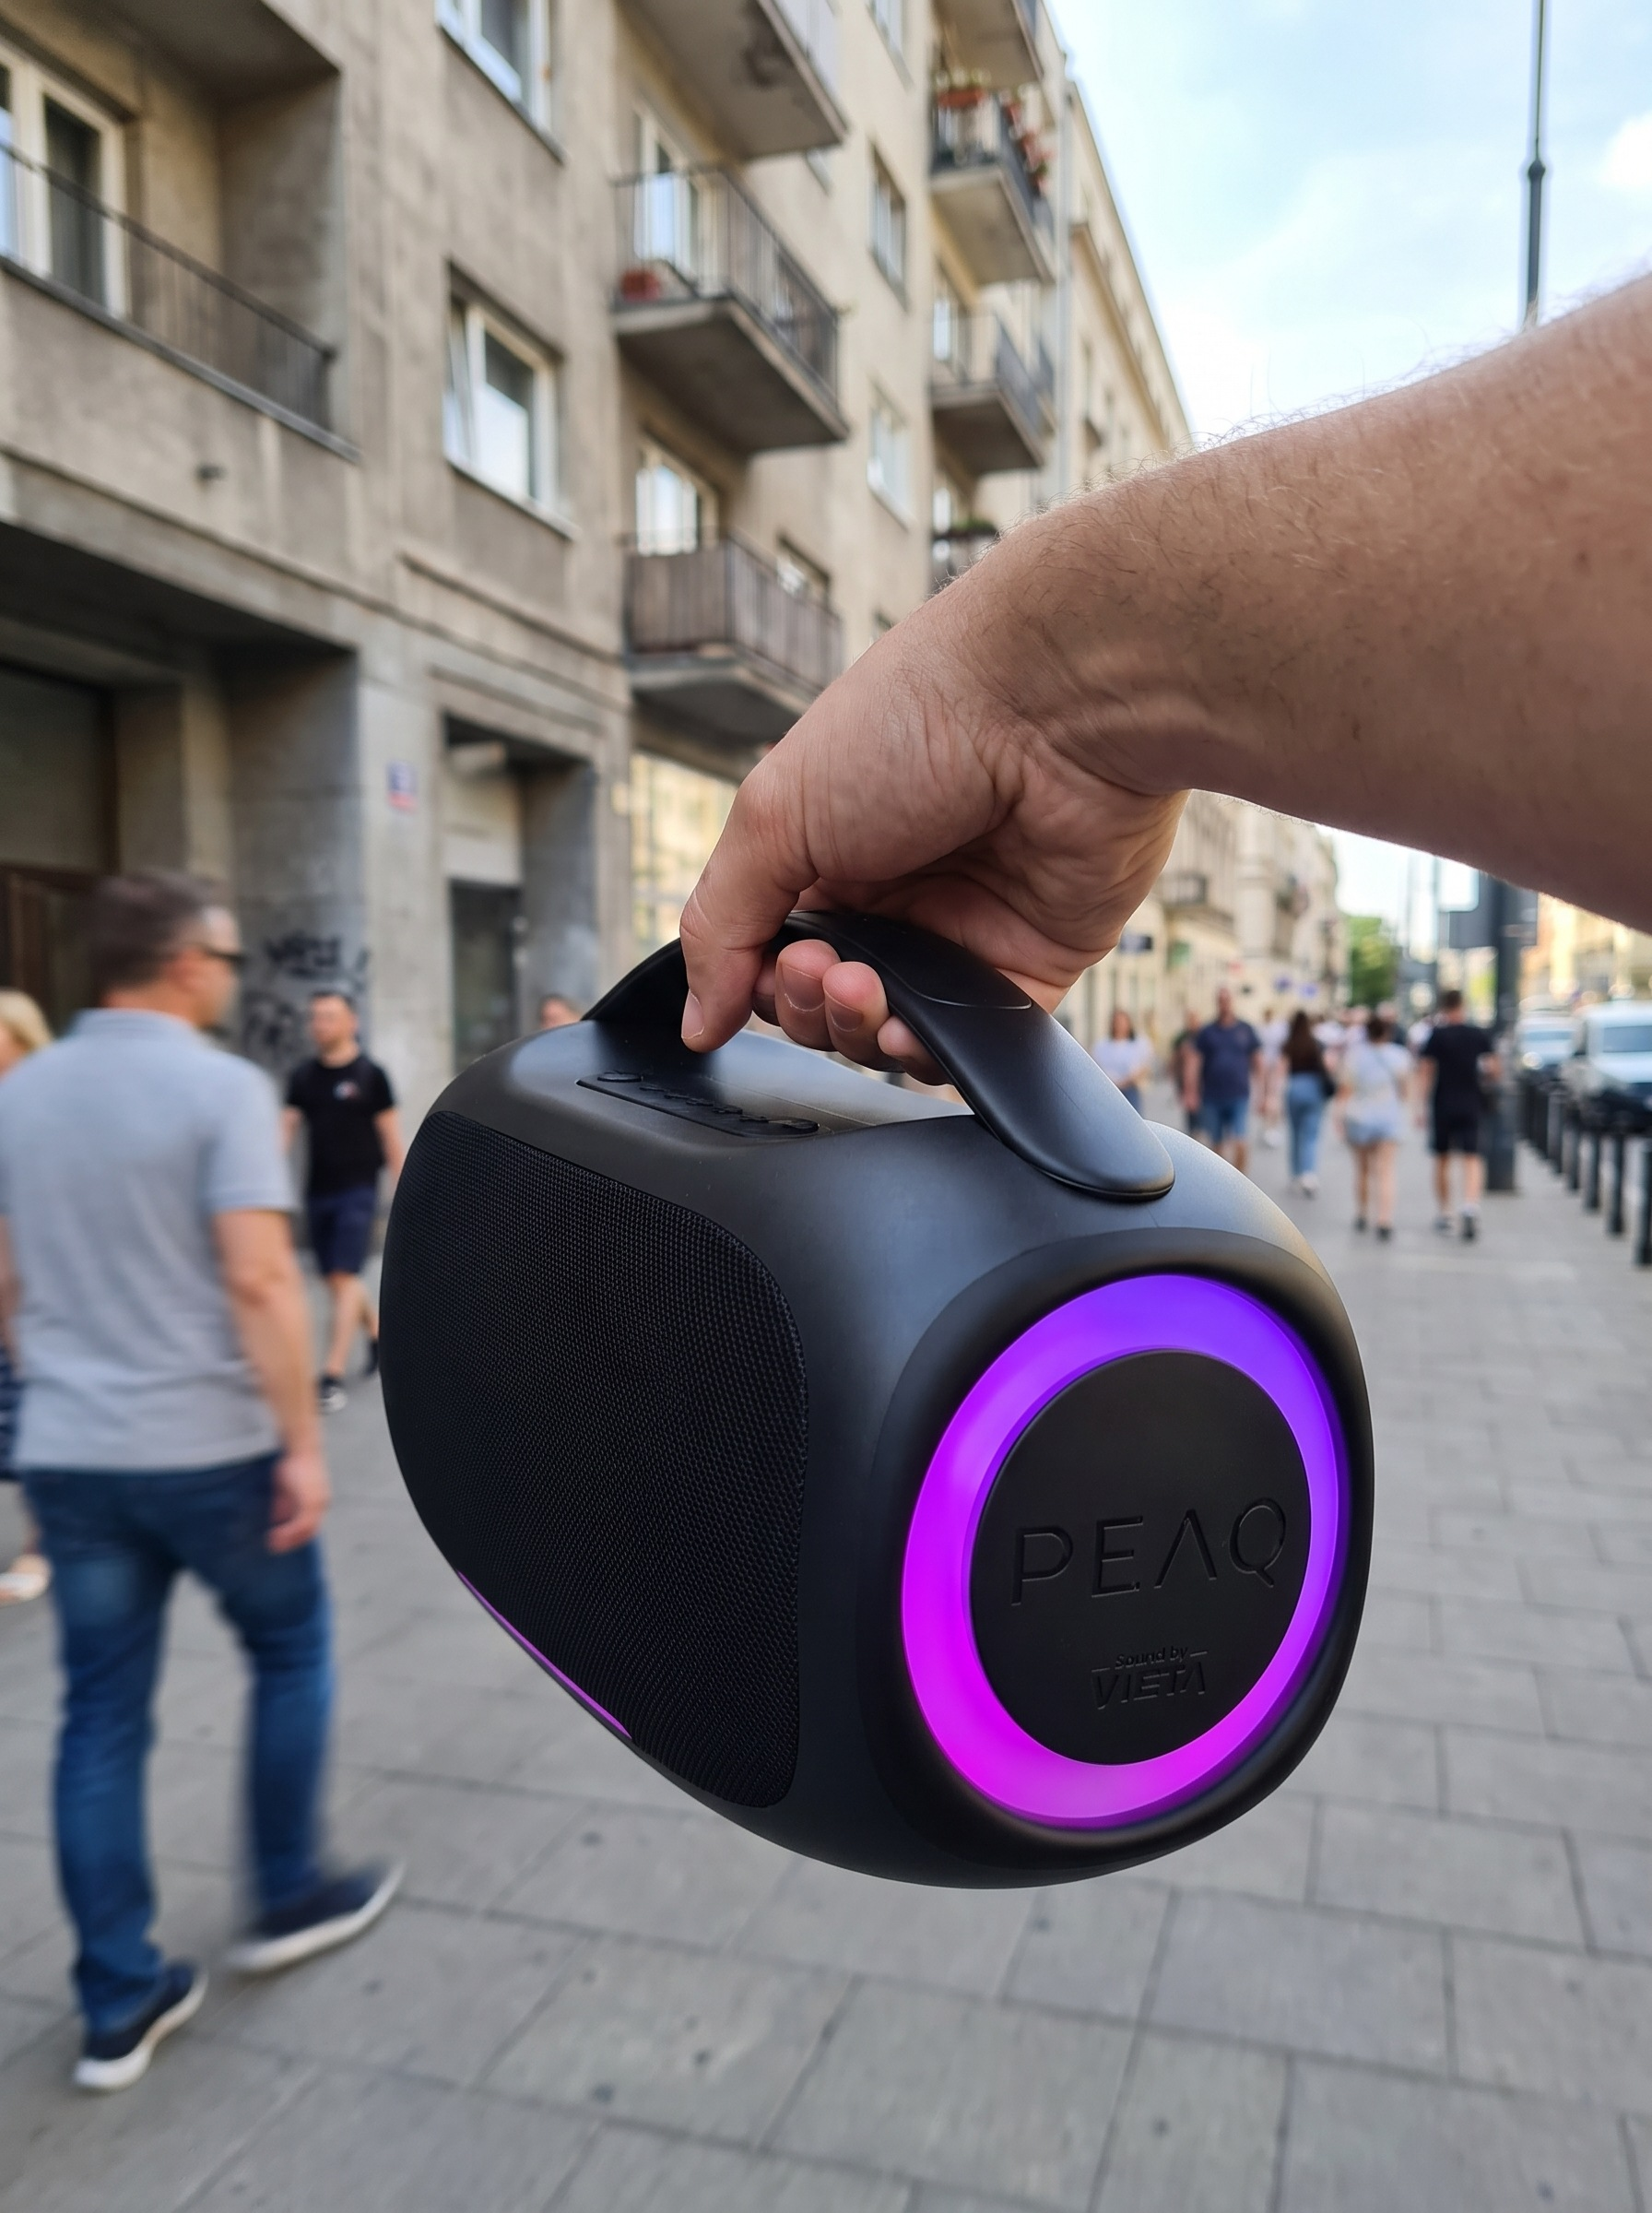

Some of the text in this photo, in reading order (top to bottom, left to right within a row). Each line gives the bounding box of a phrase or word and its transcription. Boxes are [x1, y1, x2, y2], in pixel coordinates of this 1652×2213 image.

[1011, 1497, 1287, 1606] PEAQ
[1115, 1645, 1188, 1670] Sound by
[1092, 1661, 1207, 1710] VIETA
